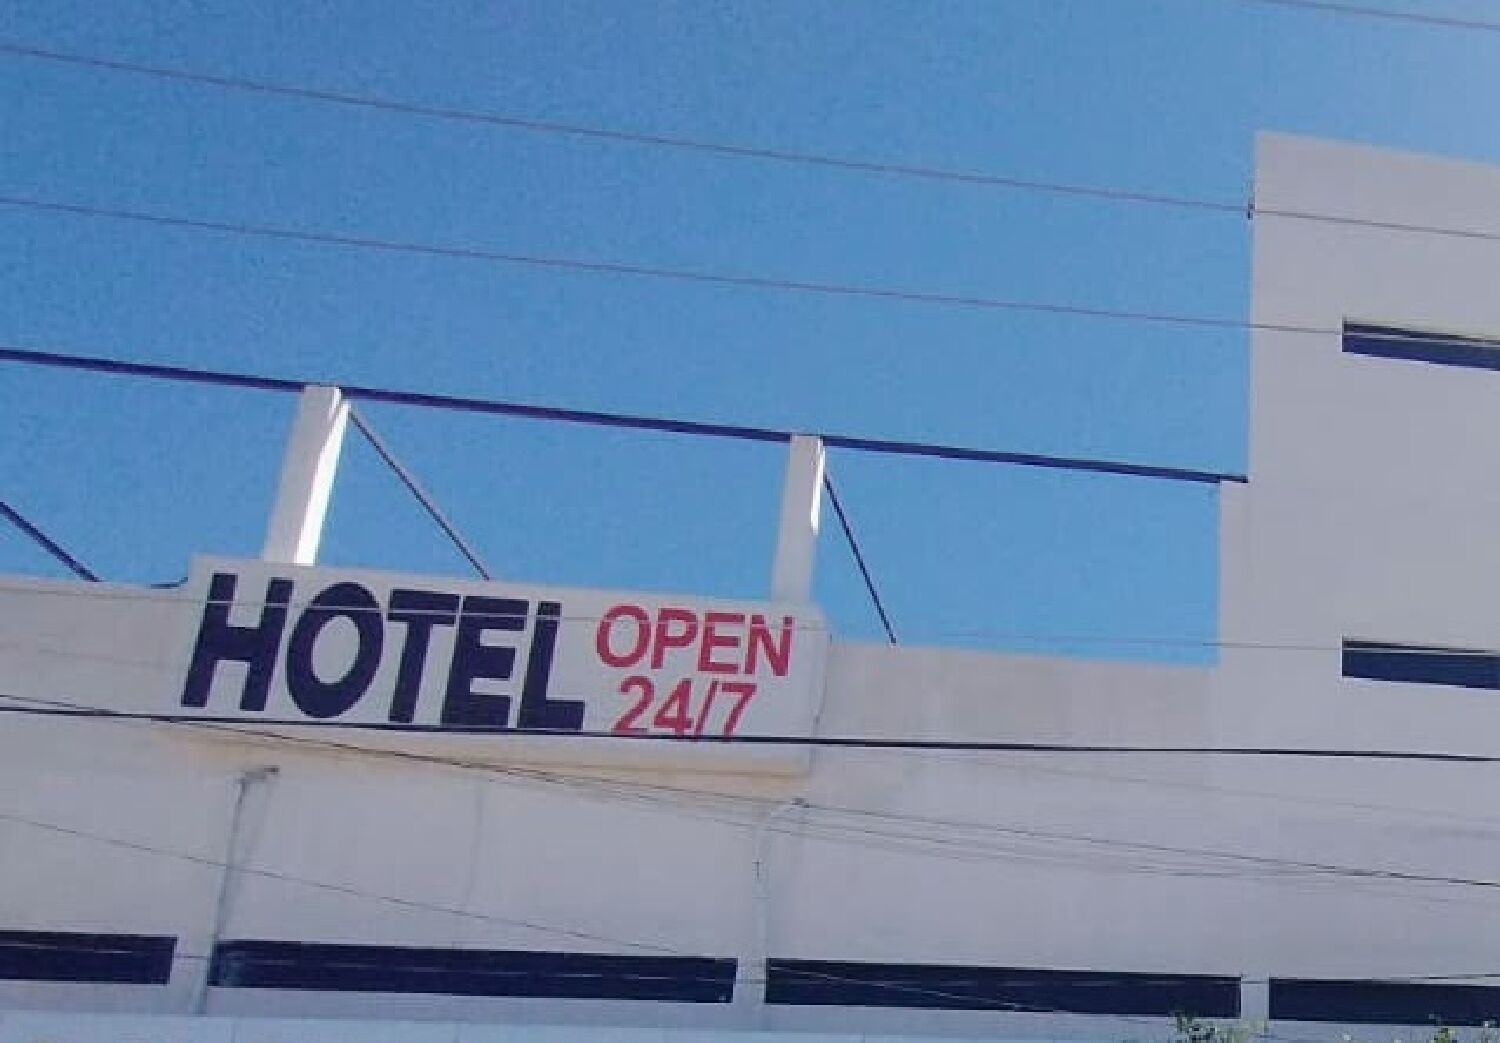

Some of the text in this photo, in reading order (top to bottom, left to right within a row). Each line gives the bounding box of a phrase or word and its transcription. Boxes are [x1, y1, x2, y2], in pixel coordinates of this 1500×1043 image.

[181, 572, 794, 732] HOTEL OPEN
[611, 675, 758, 741] 24/7
